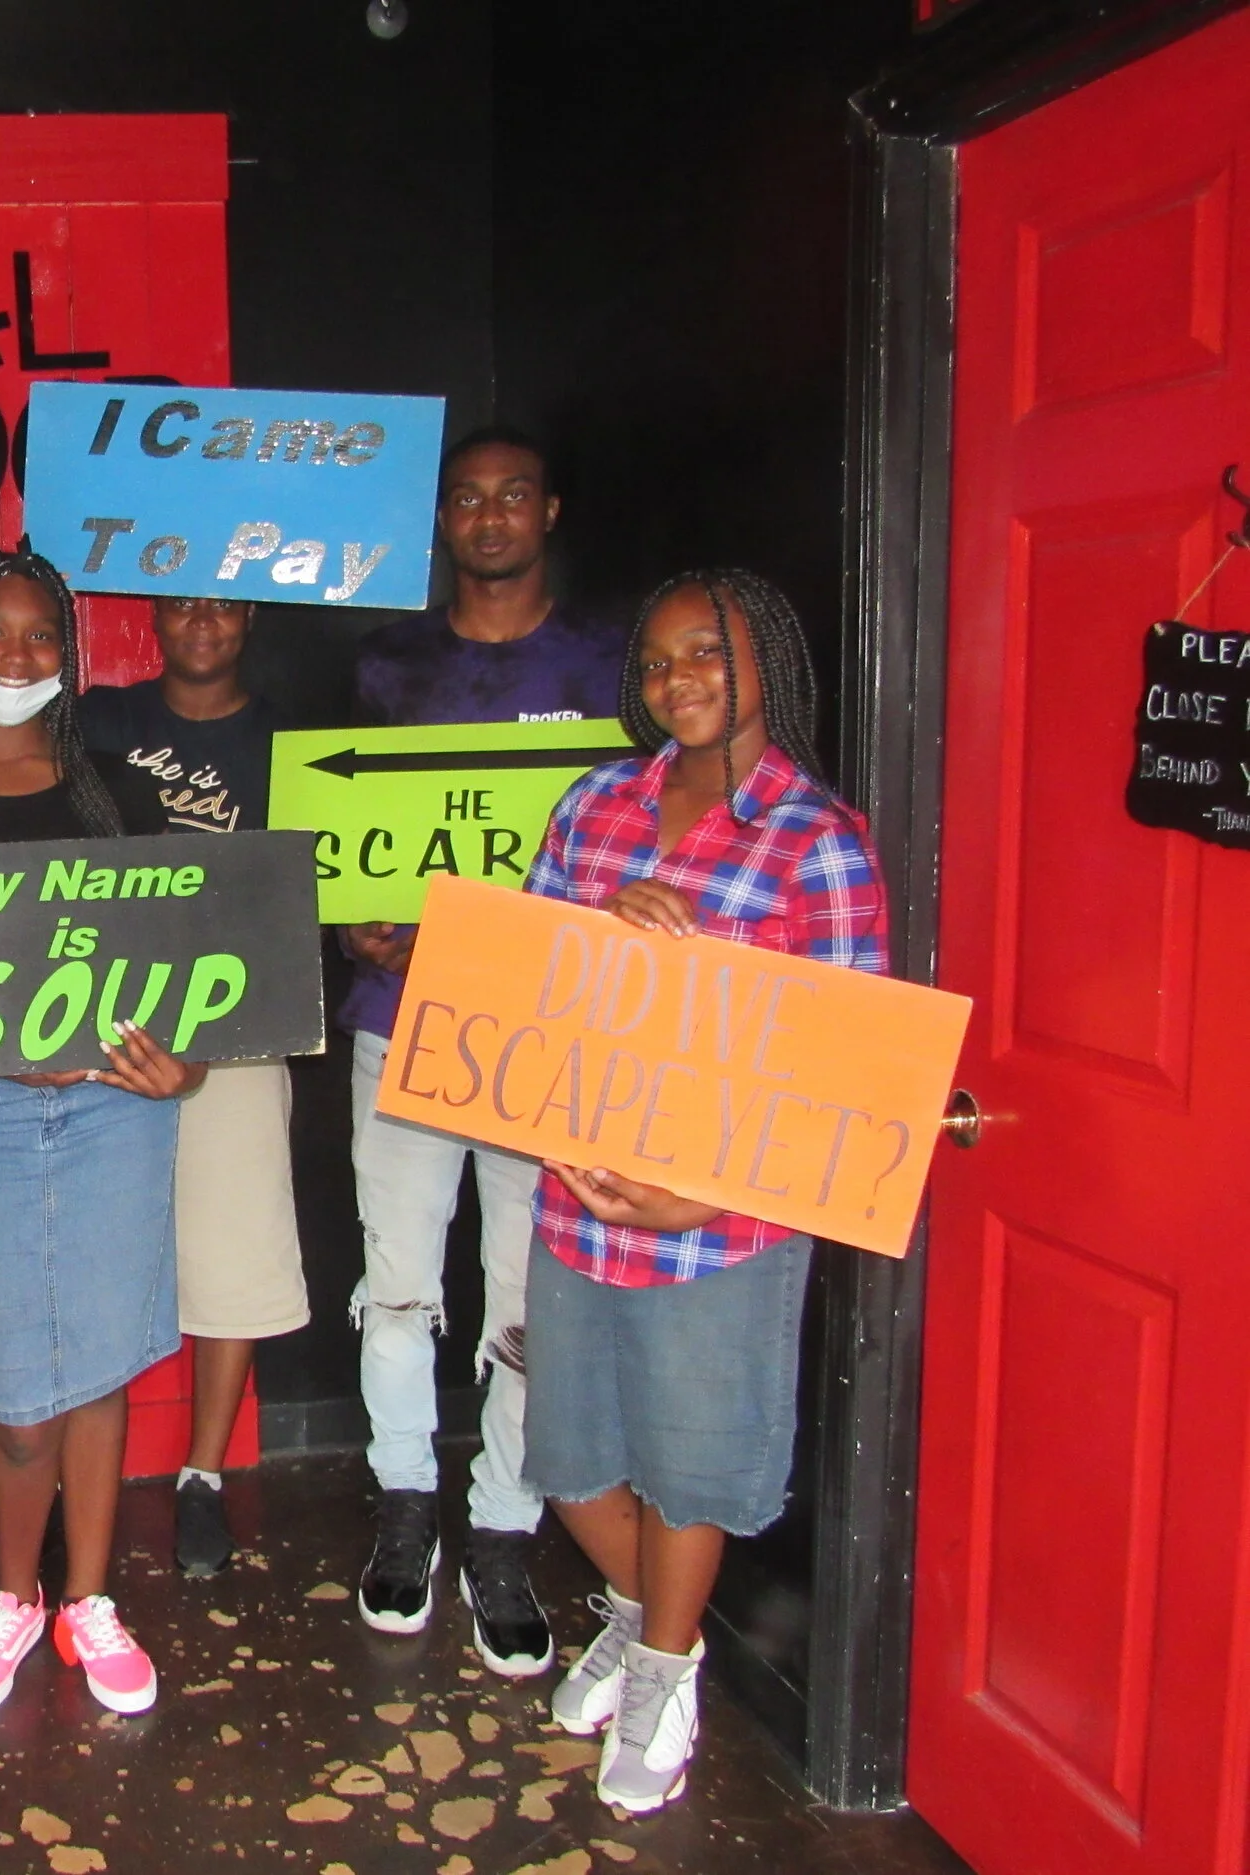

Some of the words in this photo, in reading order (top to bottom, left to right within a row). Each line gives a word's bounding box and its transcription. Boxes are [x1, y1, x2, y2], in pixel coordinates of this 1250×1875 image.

[88, 399, 125, 455] I
[140, 400, 386, 467] Came
[81, 518, 190, 577] To
[216, 521, 391, 601] Pay
[1146, 684, 1227, 725] CLOSE
[127, 747, 184, 780] she
[189, 764, 222, 789] is
[1140, 744, 1222, 785] BEHIND
[444, 789, 493, 821] HE
[315, 827, 526, 879] SCAR
[39, 858, 205, 902] Name
[48, 917, 99, 959] is
[535, 924, 658, 1036] DID
[677, 956, 818, 1080] WE
[398, 1000, 698, 1165] ESCAPE
[712, 1076, 911, 1219] YET?
